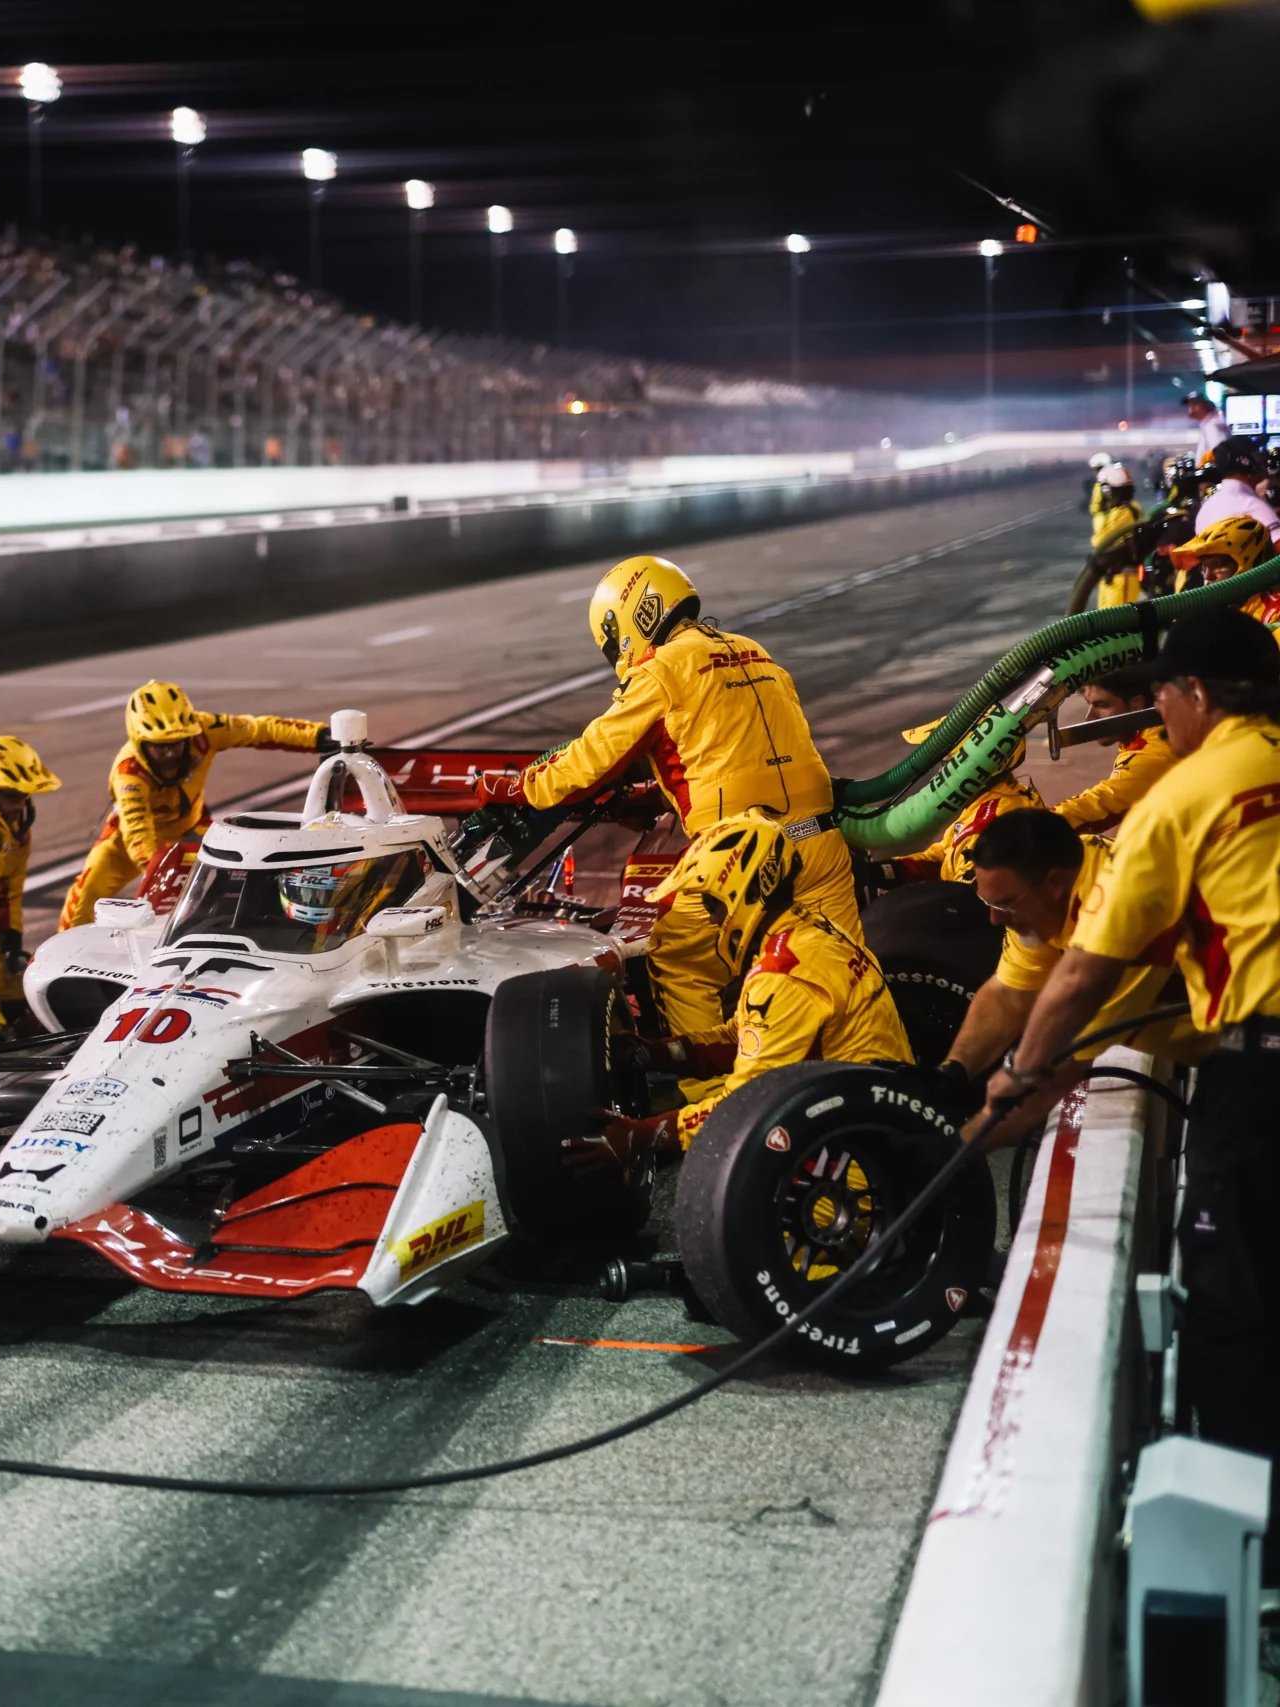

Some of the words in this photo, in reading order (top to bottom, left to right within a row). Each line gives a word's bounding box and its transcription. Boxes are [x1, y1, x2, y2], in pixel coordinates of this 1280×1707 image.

[622, 570, 645, 603] DHL
[709, 650, 768, 669] DHL
[718, 848, 743, 886] DHL
[301, 875, 330, 885] HRC
[424, 915, 444, 931] HRC
[883, 972, 976, 1000] restone
[104, 1007, 192, 1044] 10
[93, 1089, 121, 1098] CAR
[10, 1138, 91, 1153] JIFFY
[408, 1213, 471, 1270] DHL
